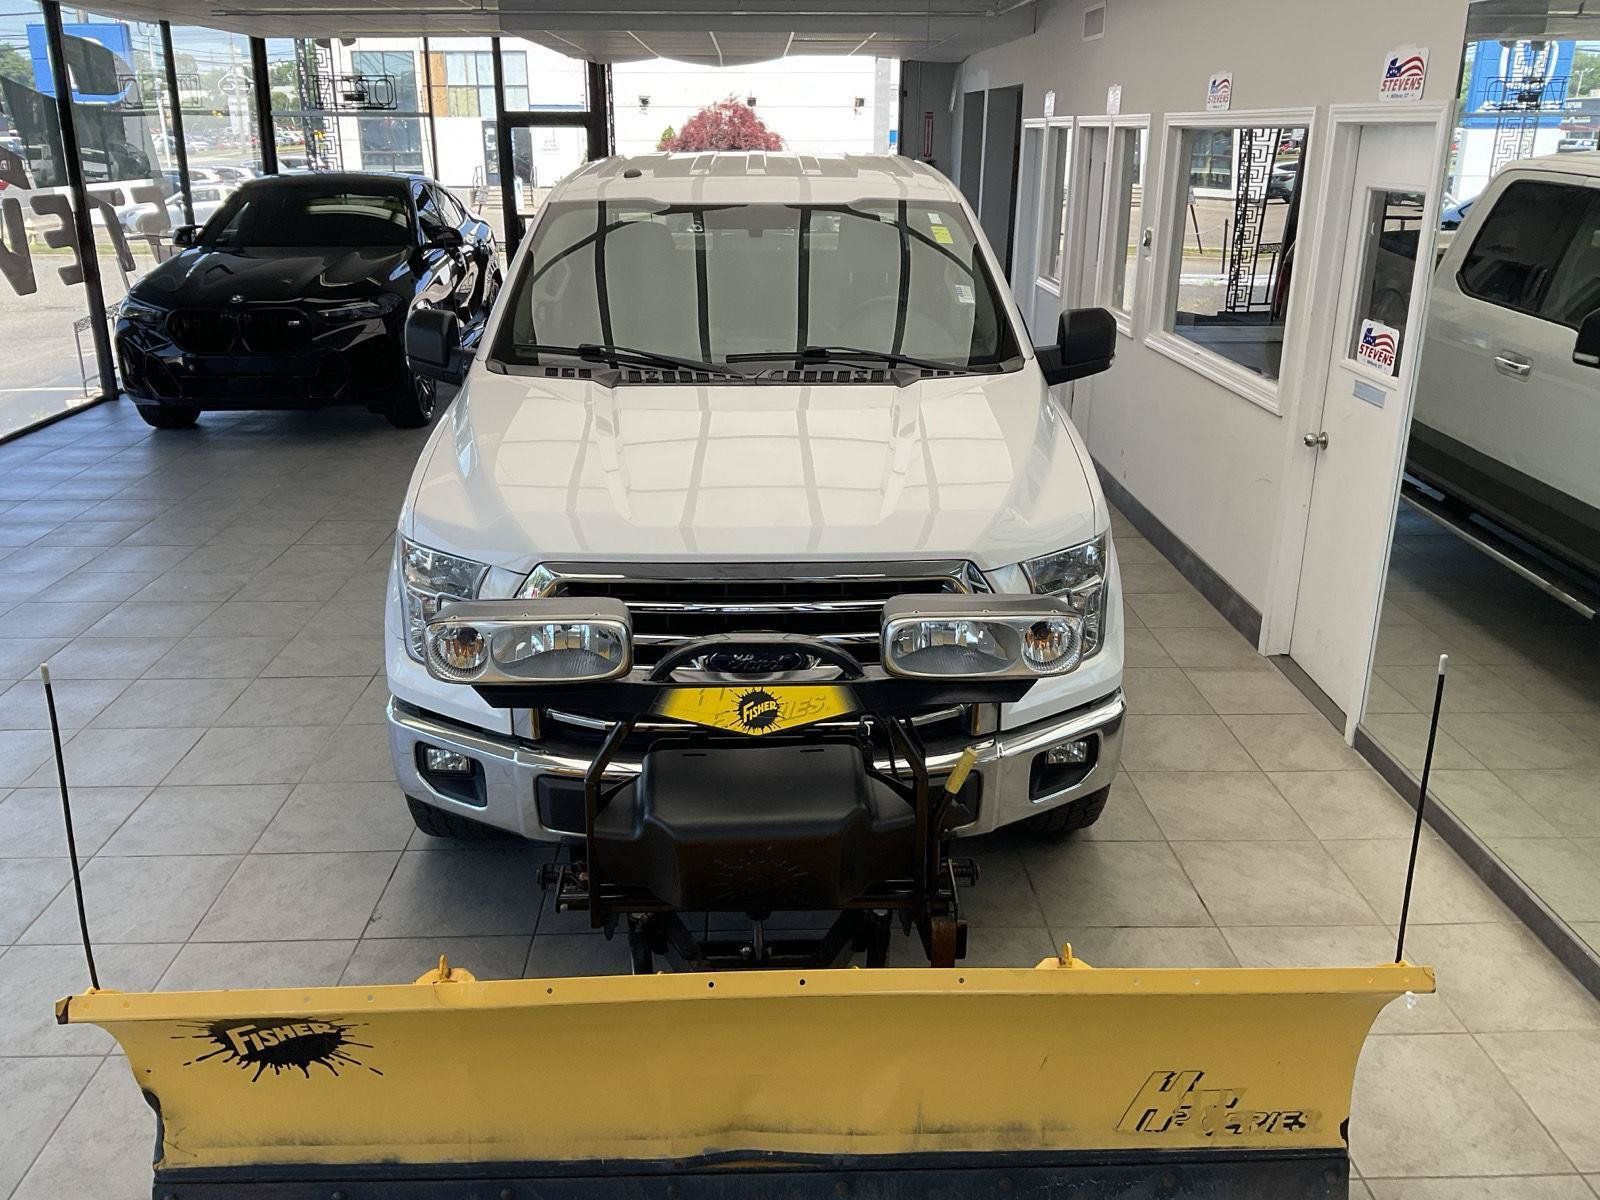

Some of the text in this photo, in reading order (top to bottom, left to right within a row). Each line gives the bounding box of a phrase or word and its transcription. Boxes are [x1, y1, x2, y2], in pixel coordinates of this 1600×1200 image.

[1381, 77, 1423, 92] STEVENS
[1358, 343, 1394, 367] STEVENS
[742, 701, 779, 723] FISHER
[226, 1023, 339, 1056] FISHER
